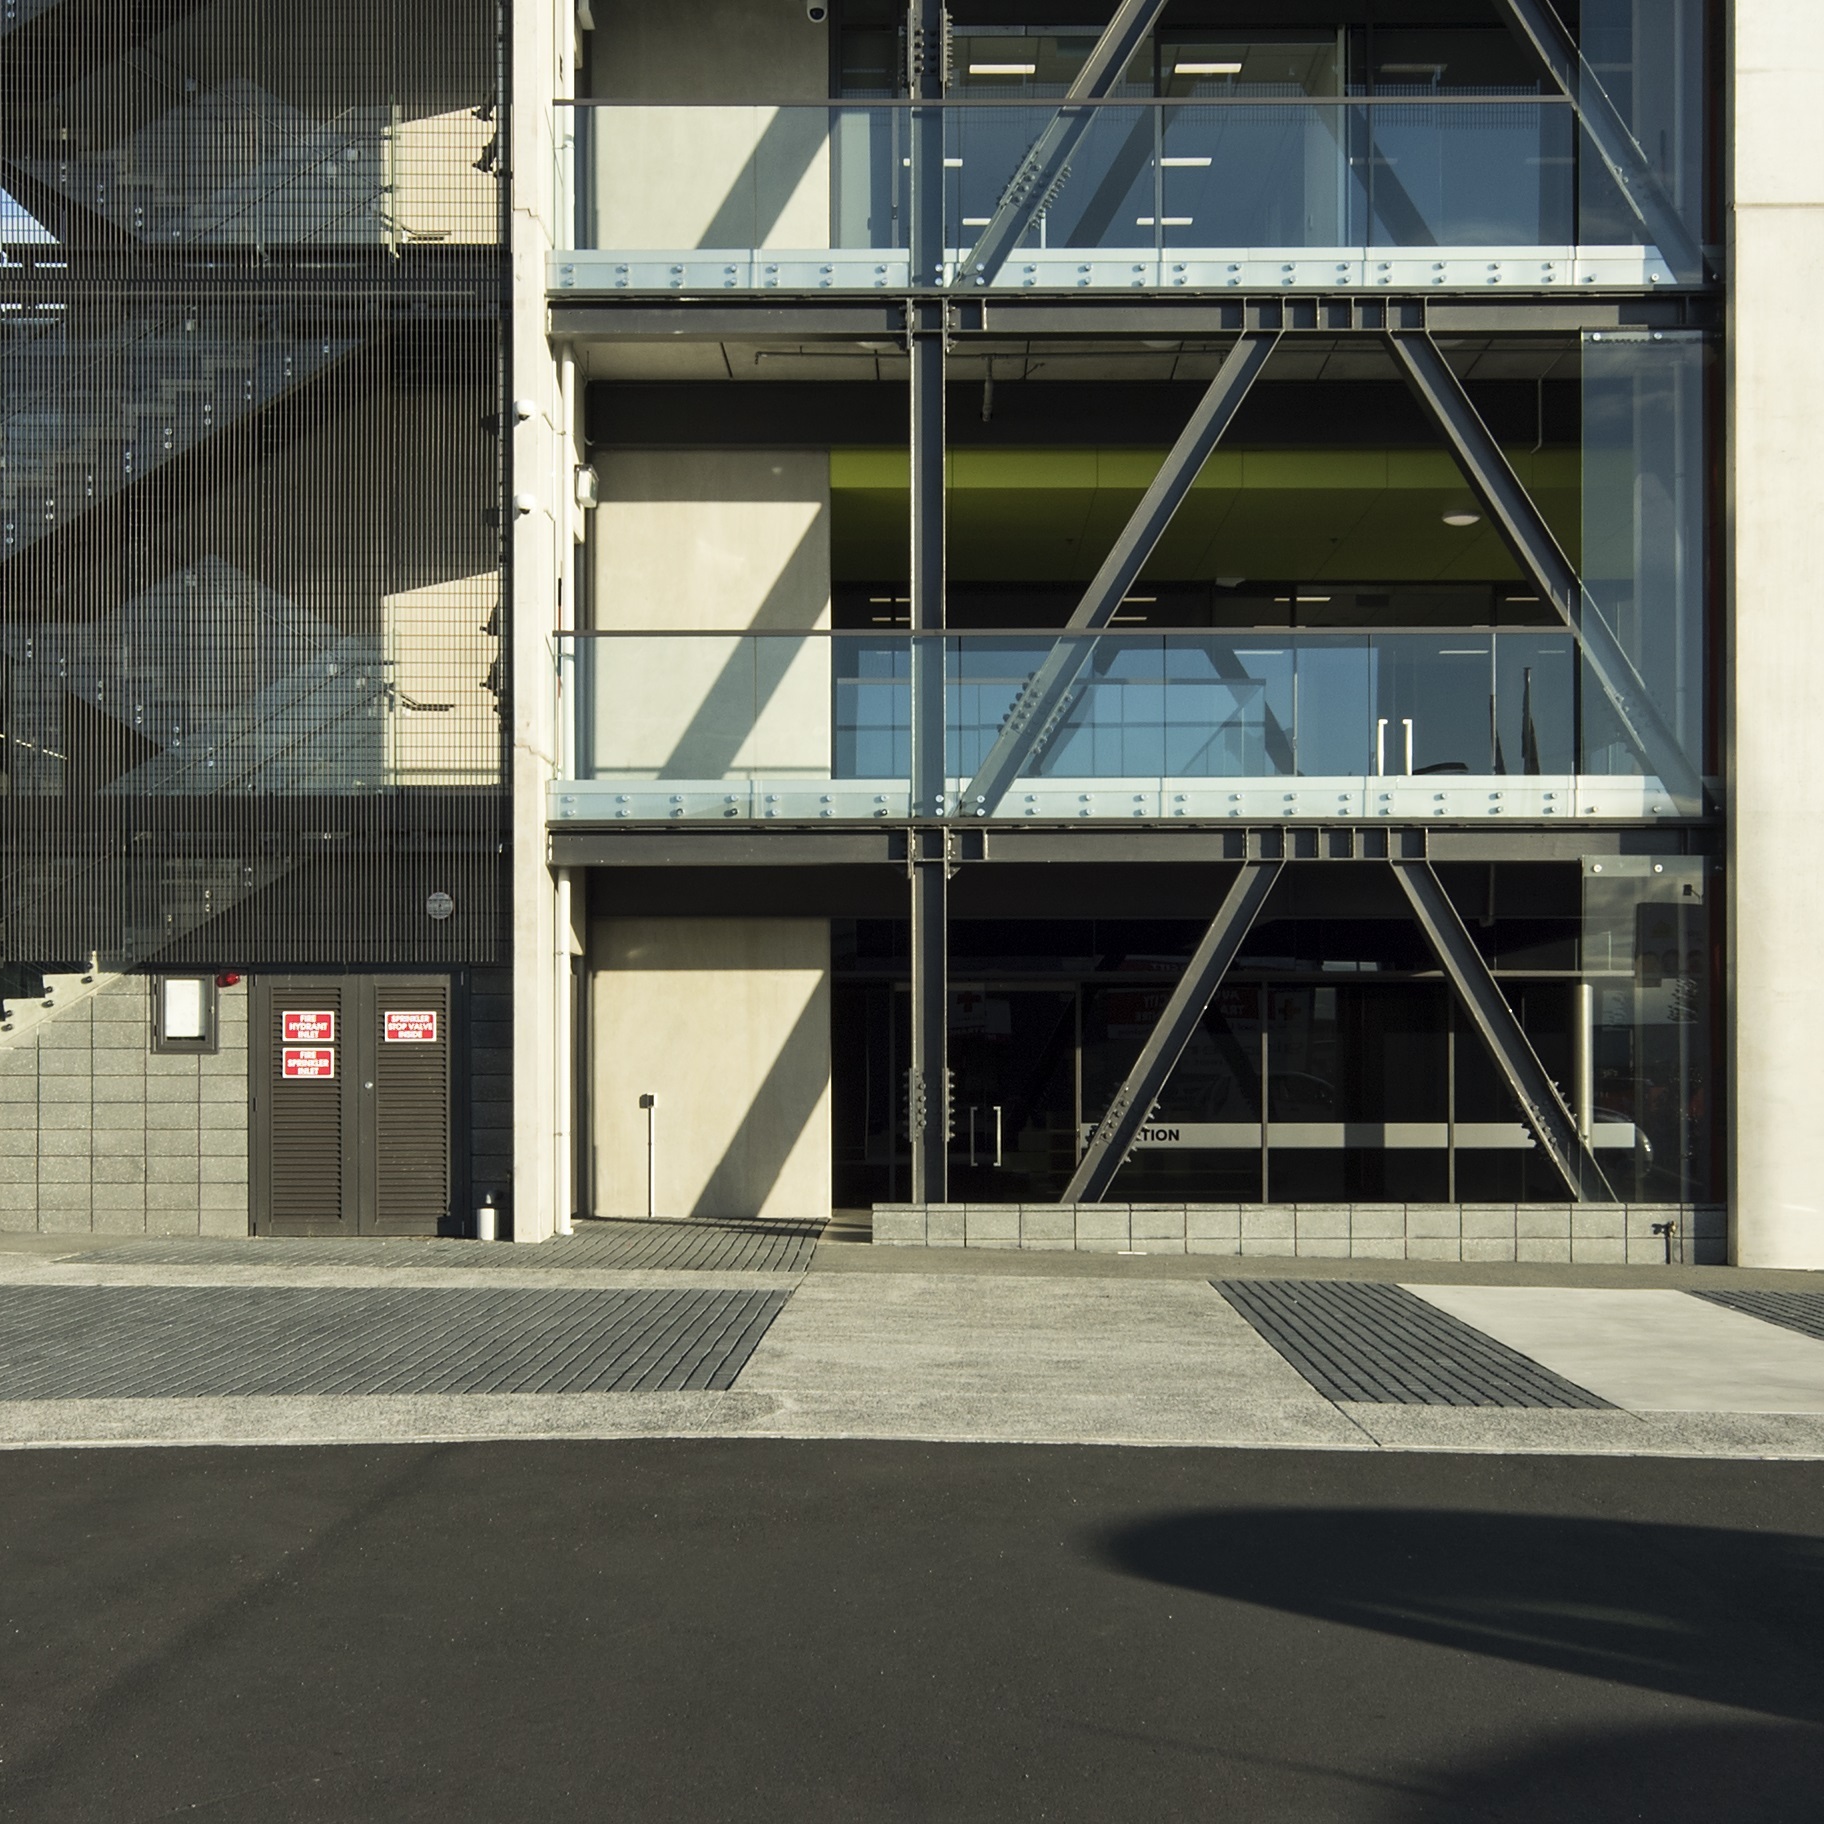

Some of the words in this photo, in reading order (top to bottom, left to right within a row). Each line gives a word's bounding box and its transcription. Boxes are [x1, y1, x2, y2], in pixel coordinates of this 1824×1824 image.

[299, 1014, 317, 1022] FIRE
[391, 1014, 430, 1023] SPRINKLER
[288, 1022, 328, 1031] HYDRANT
[388, 1022, 407, 1030] STOP
[408, 1022, 433, 1030] VALVE
[297, 1030, 319, 1039] INLET
[398, 1030, 423, 1039] INSIDE
[299, 1050, 317, 1059] FIRE
[287, 1058, 329, 1067] SPRINKLER
[297, 1066, 319, 1075] INLET
